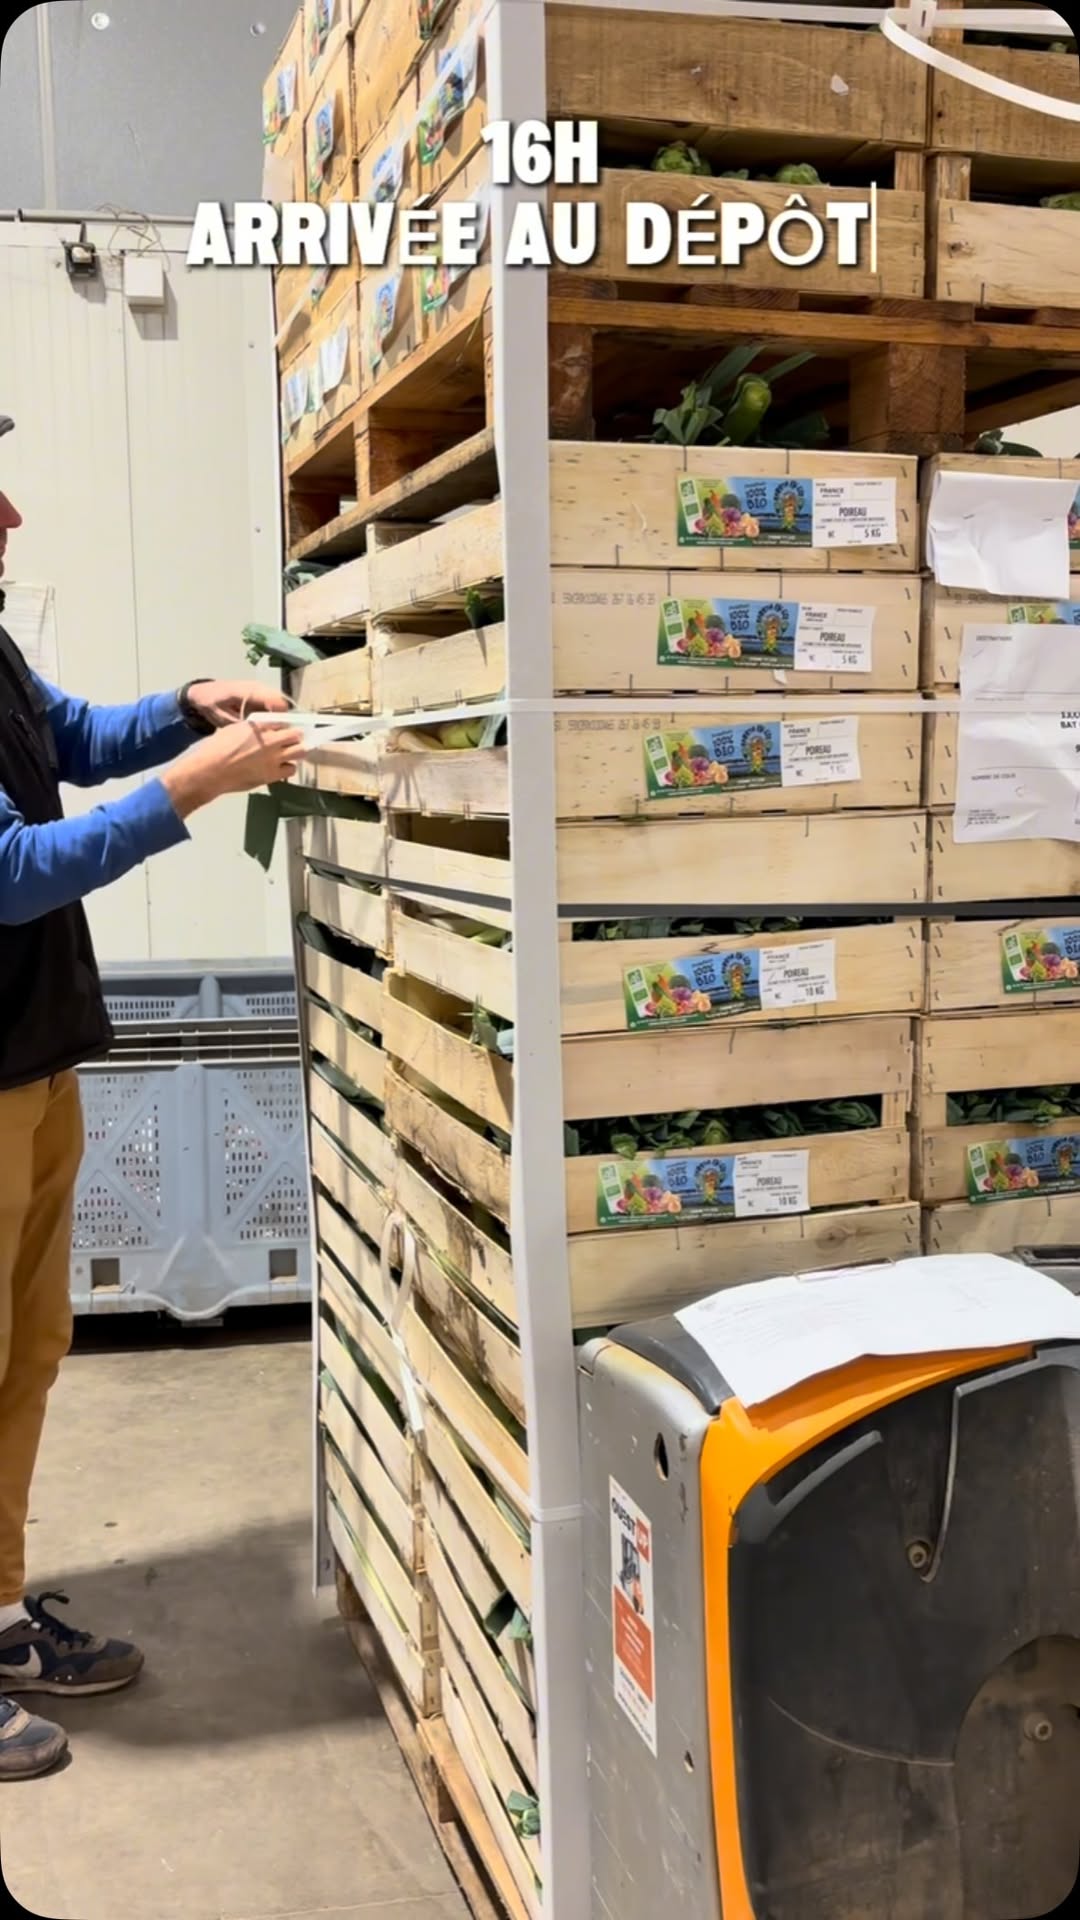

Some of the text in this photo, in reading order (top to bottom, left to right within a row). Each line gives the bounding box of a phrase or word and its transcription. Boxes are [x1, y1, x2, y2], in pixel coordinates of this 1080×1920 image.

[838, 507, 867, 517] POIREAU
[871, 528, 881, 538] KG
[819, 632, 846, 642] POIREAU
[805, 744, 832, 755] POIREAU
[783, 967, 809, 978] POIREAU
[756, 1176, 783, 1187] POIREAU
